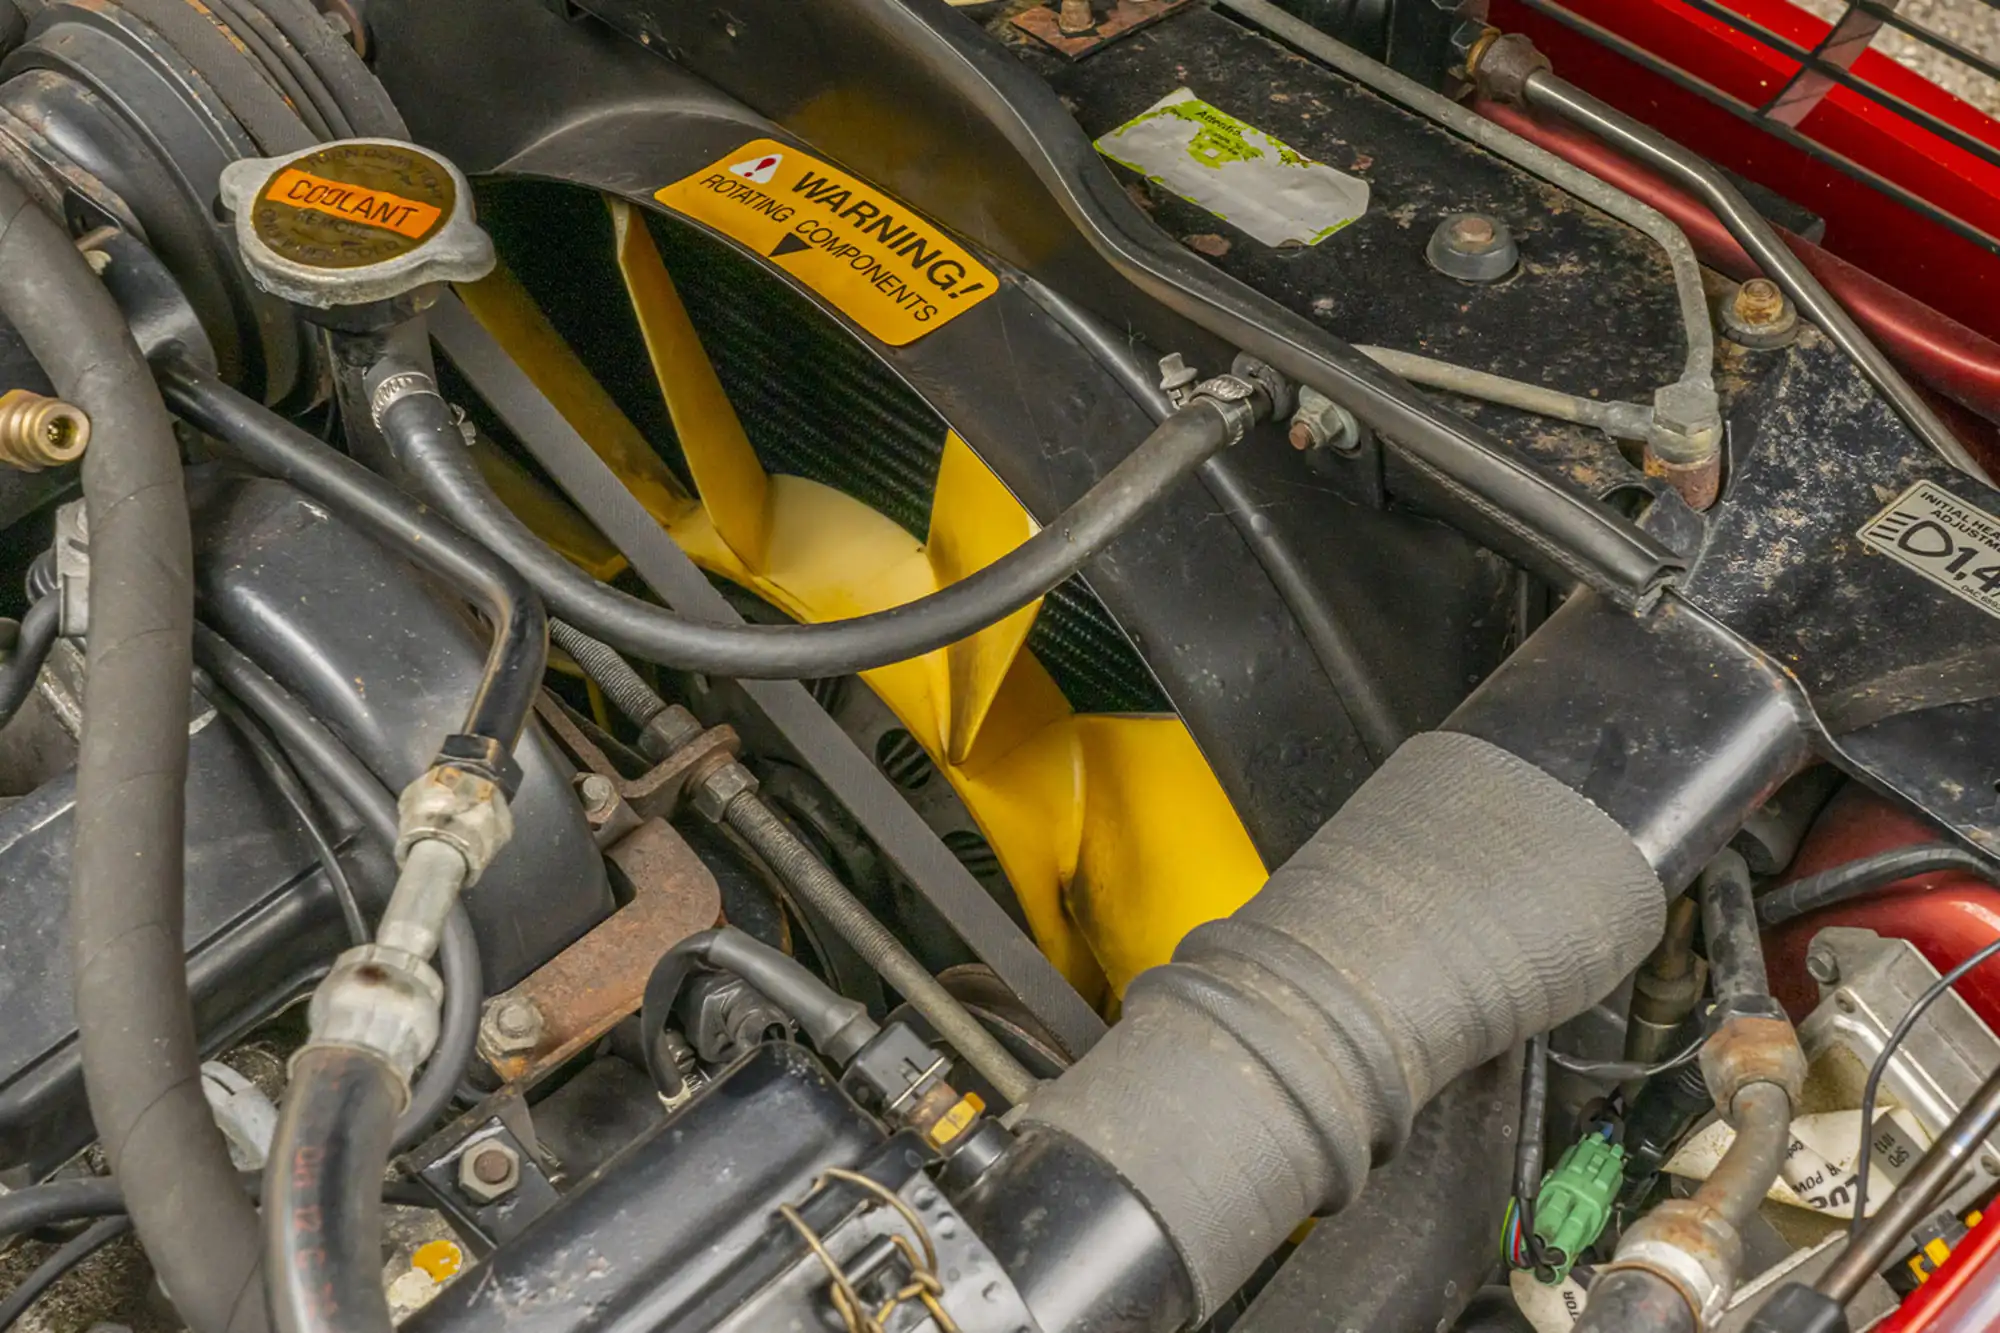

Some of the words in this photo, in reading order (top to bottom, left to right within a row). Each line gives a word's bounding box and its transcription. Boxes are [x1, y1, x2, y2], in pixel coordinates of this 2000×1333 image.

[287, 180, 418, 228] COOLANT
[699, 174, 796, 224] ROTATING
[795, 219, 938, 322] COMPONENTS
[791, 171, 984, 300] WARNING!
[1920, 492, 1969, 523] INITIAL
[1944, 547, 2000, 597] 1,4
